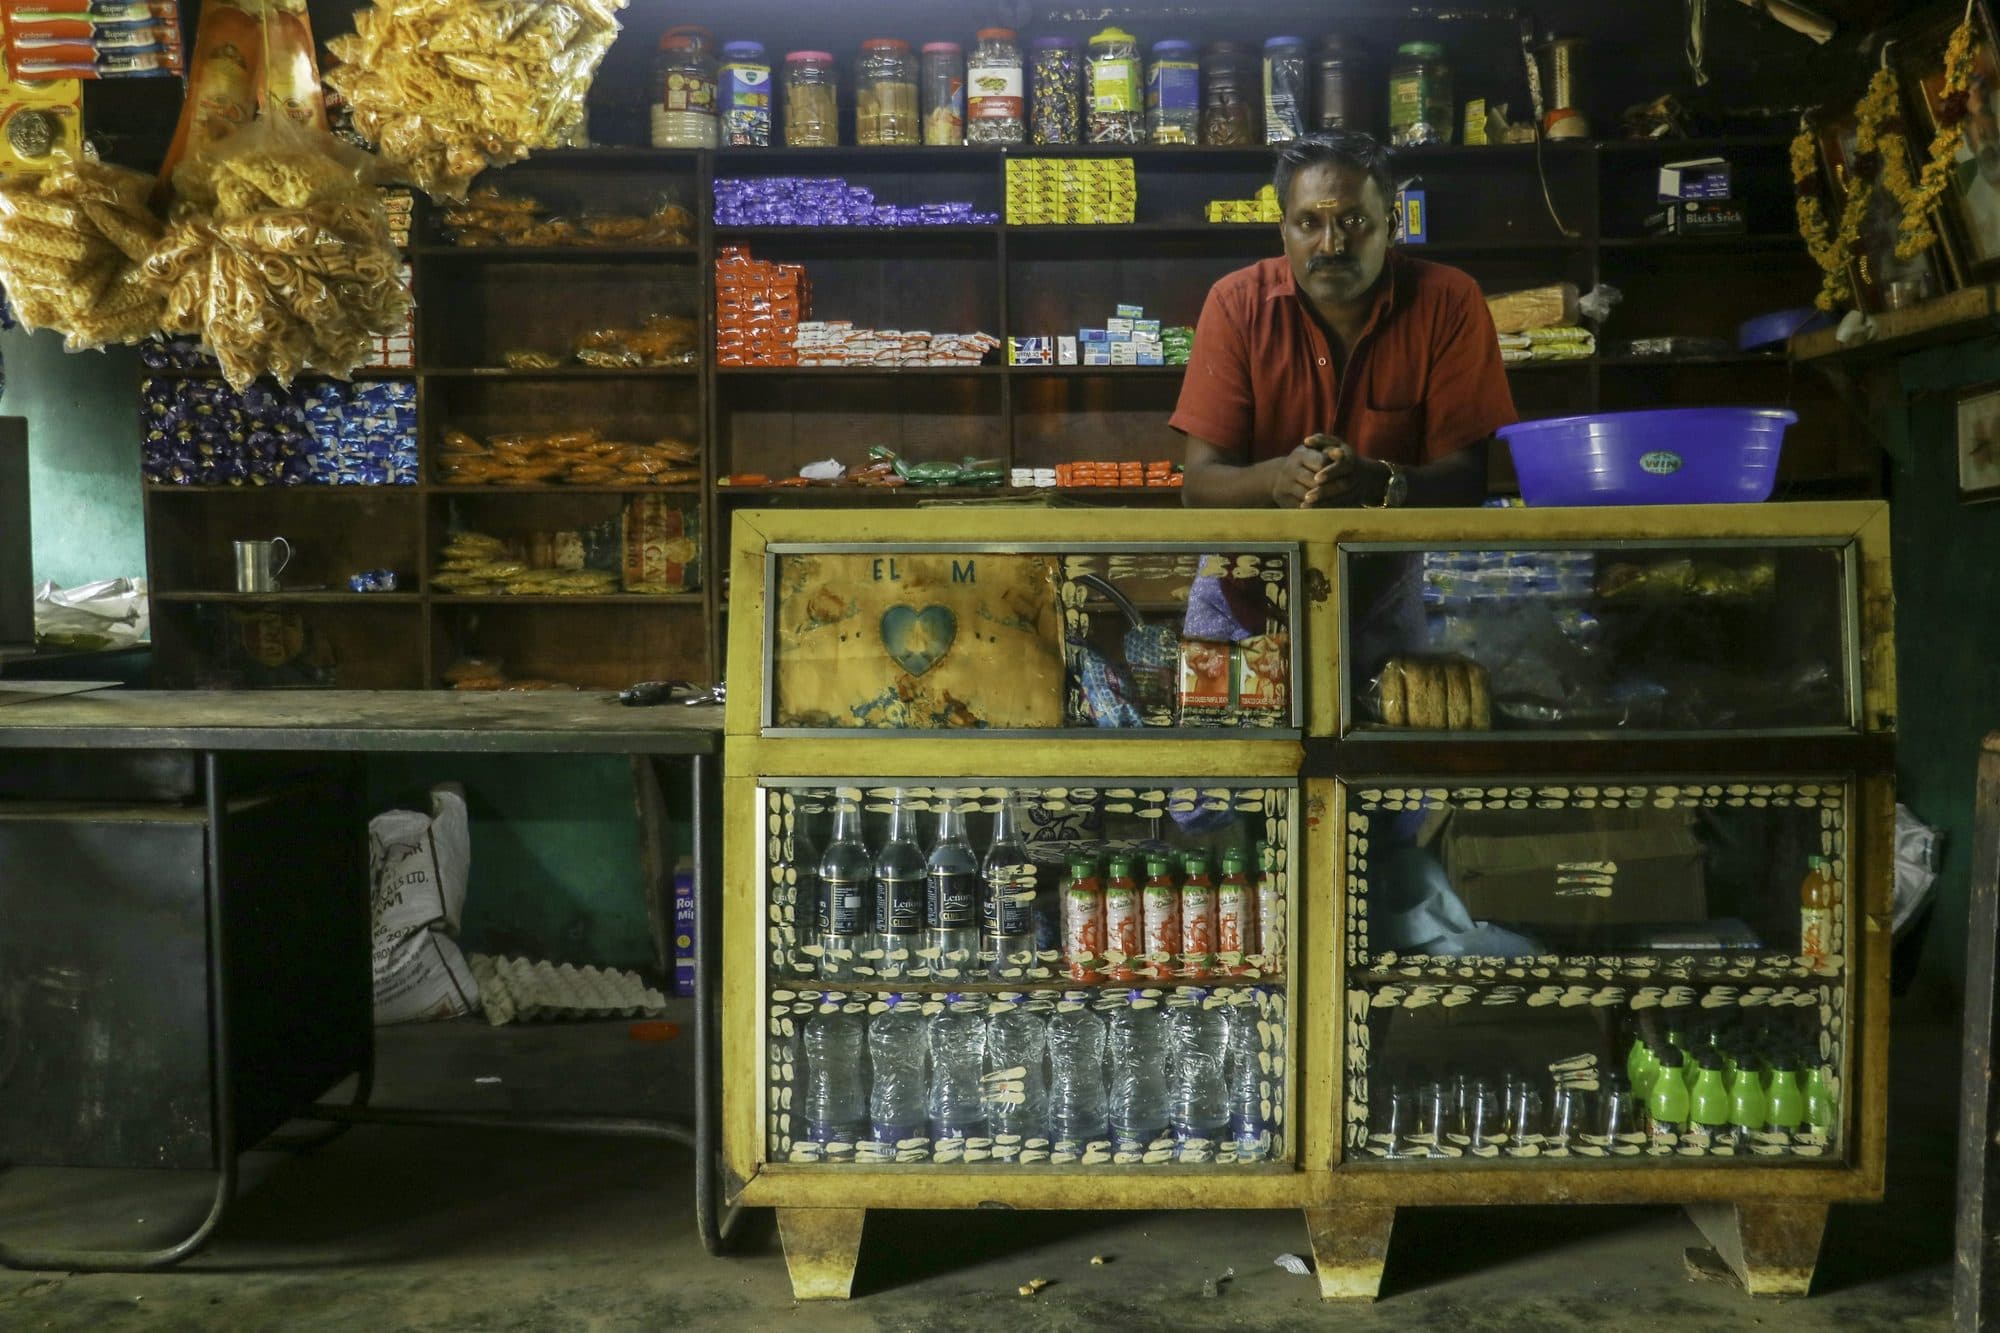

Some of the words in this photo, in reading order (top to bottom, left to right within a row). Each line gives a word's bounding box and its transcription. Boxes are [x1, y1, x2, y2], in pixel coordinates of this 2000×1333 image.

[101, 5, 125, 14] Super
[104, 31, 128, 40] Super
[108, 56, 131, 65] Super
[1686, 213, 1713, 223] Black
[952, 559, 975, 583] M
